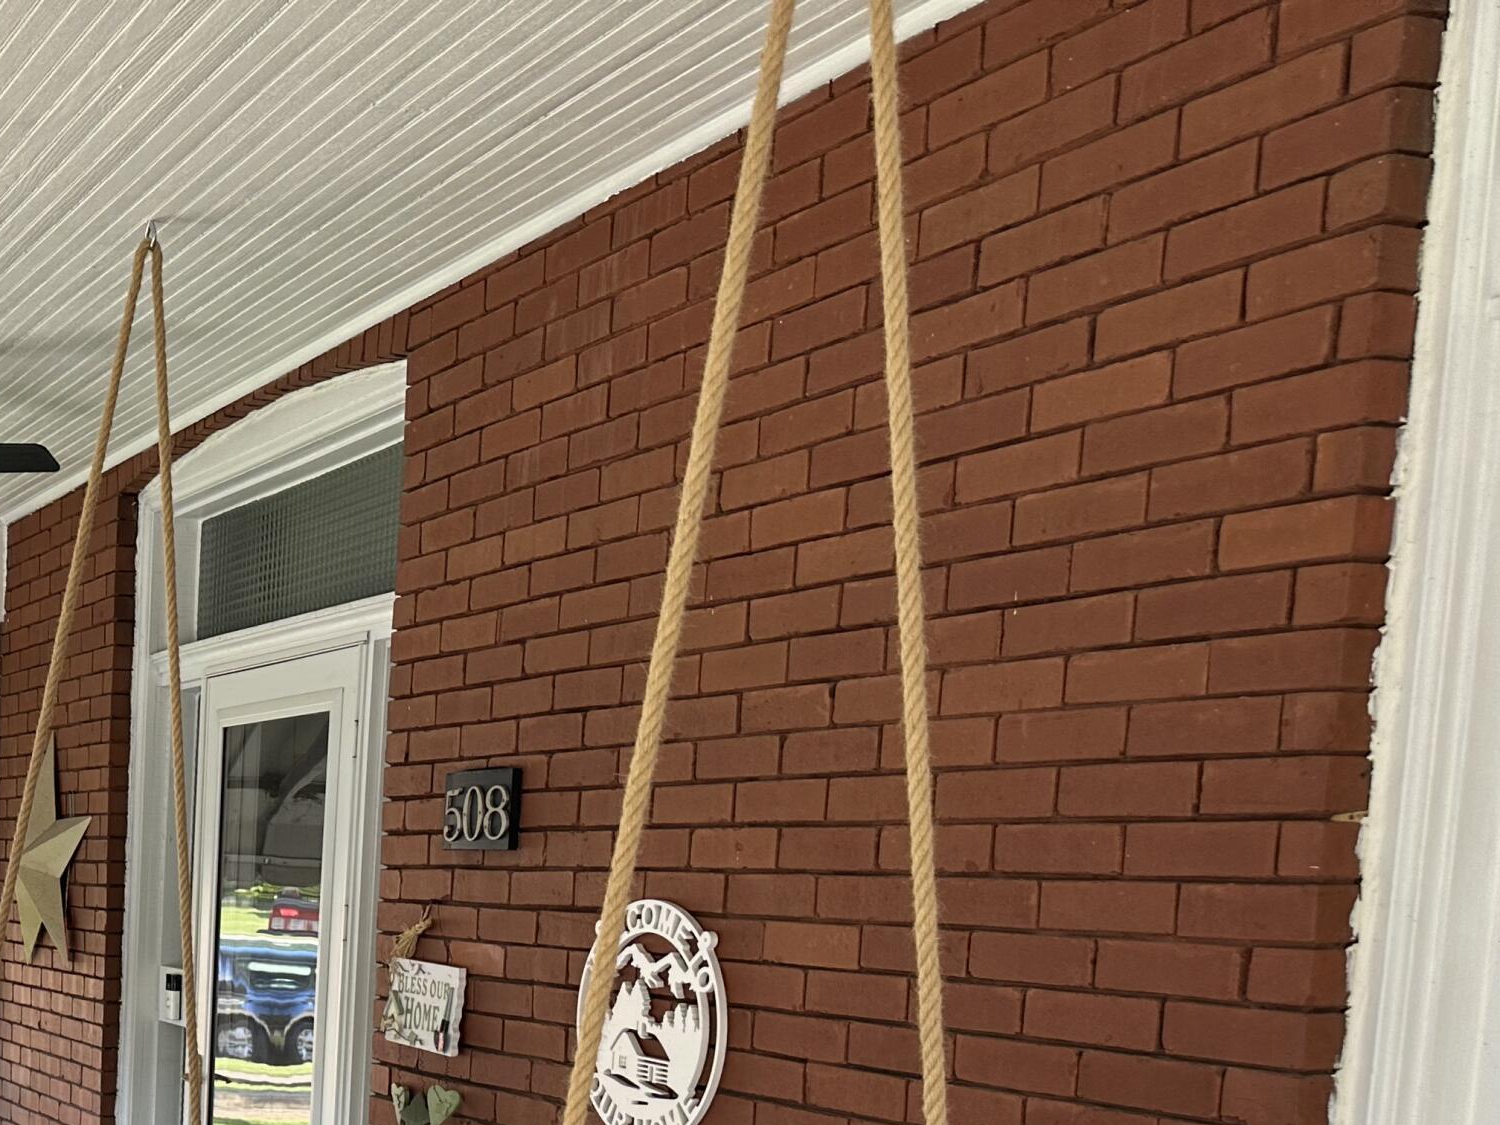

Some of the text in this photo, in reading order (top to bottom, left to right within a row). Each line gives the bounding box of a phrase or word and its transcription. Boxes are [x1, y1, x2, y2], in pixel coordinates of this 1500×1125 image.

[443, 785, 509, 842] 508
[398, 972, 451, 1000] BLESS OUR
[404, 996, 440, 1032] HOME
